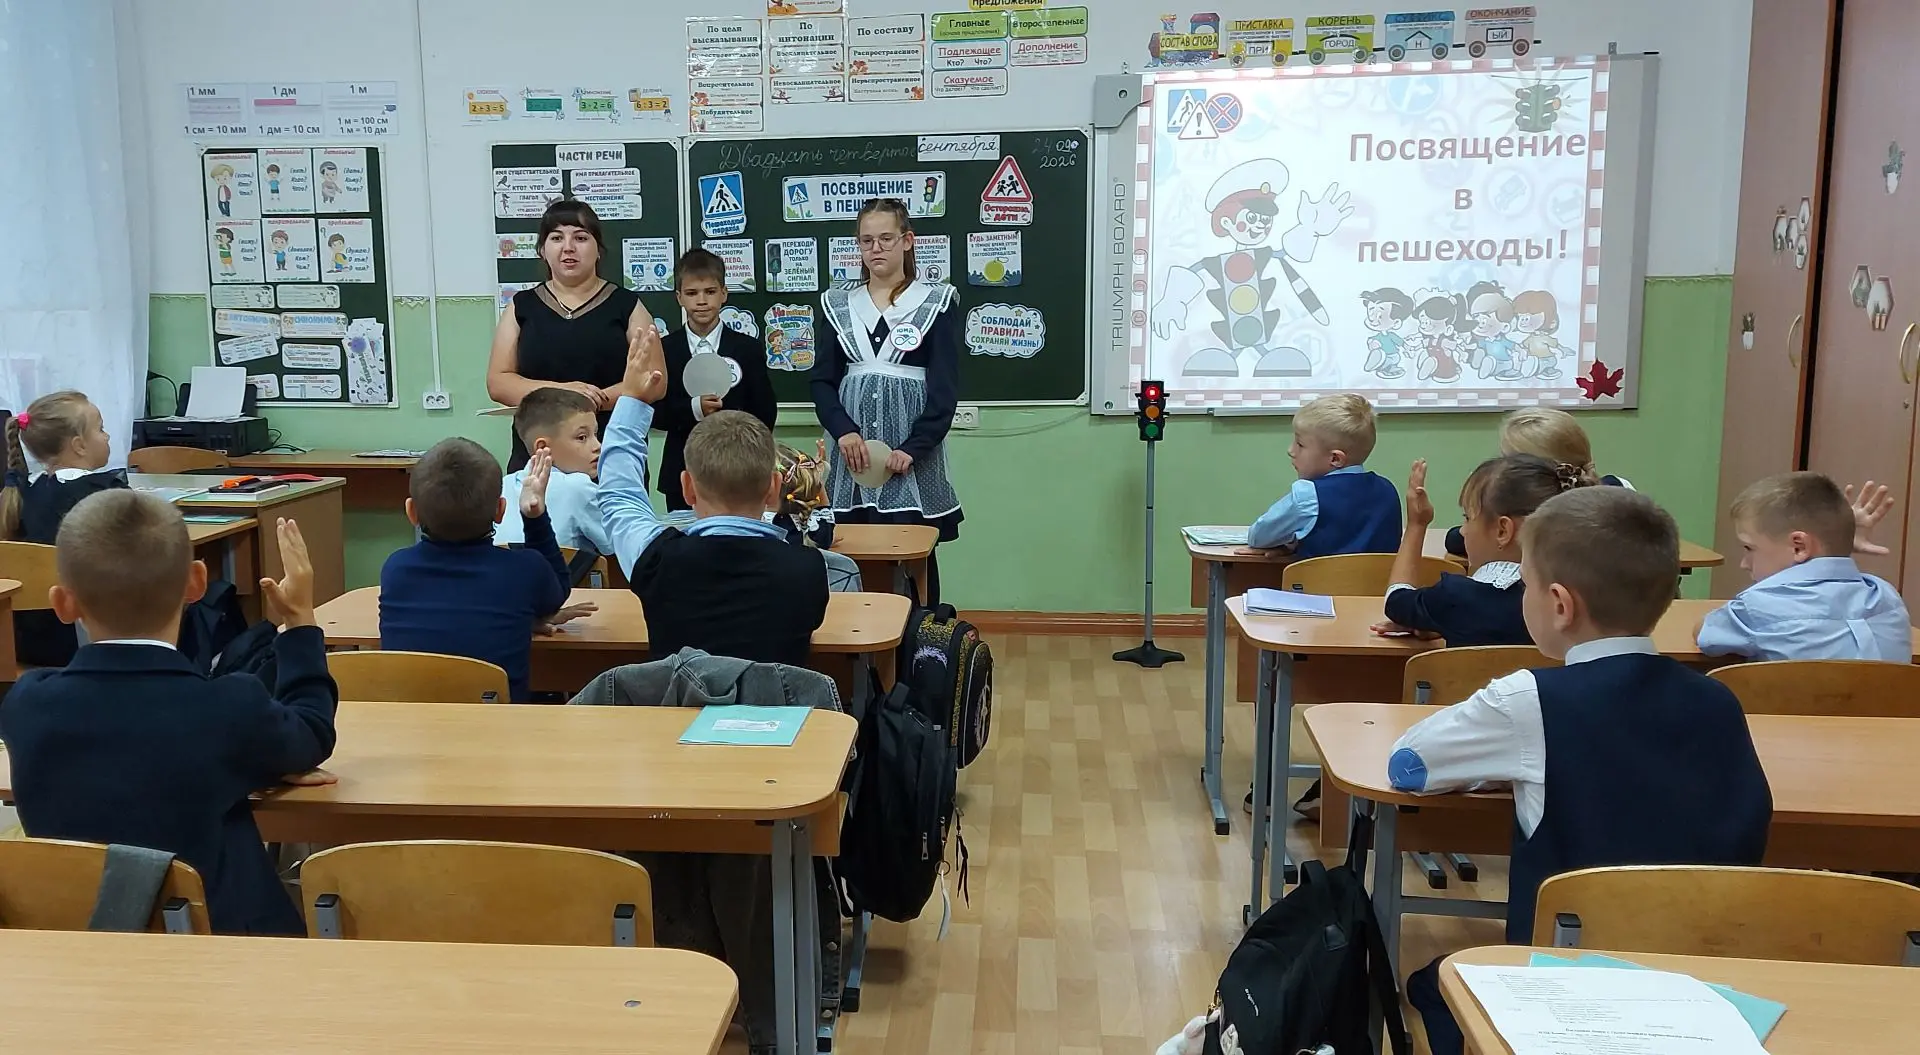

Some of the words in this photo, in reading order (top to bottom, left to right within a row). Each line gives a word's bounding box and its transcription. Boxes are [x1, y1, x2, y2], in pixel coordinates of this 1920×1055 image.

[1470, 7, 1531, 18] ОКОНЧАНИЕ
[949, 19, 991, 28] Главные
[1234, 19, 1284, 30] ПРИСТАВКА
[1318, 15, 1361, 26] КОРЕНЬ
[800, 22, 813, 30] По
[857, 28, 871, 36] По
[874, 26, 915, 34] составу
[692, 36, 758, 44] высказывания
[778, 34, 835, 43] интонации
[1492, 31, 1508, 40] ЫЙ
[1160, 35, 1190, 47] СОСТАВ
[1324, 39, 1356, 48] ГОРОД
[1415, 40, 1423, 48] Н
[938, 47, 1001, 57] Подлежащее
[1018, 42, 1079, 52] Дополнение
[1249, 46, 1270, 55] ПРИ
[946, 58, 965, 67] Кто?
[974, 57, 993, 66] Что?
[943, 75, 994, 86] Сказуемое
[190, 87, 195, 96] 1
[198, 88, 216, 96] мм
[272, 86, 277, 95] 1
[280, 87, 297, 97] дм
[350, 85, 355, 94] 1
[471, 104, 477, 112] 2
[485, 104, 491, 112] 3
[499, 104, 505, 112] 5
[580, 101, 586, 109] 3
[593, 101, 598, 109] 2
[606, 101, 612, 109] 6
[636, 101, 642, 109] 6
[648, 101, 653, 109] 3
[662, 100, 668, 108] 2
[338, 116, 342, 125] 1
[361, 116, 375, 125] 100
[184, 126, 189, 134] 1
[216, 125, 228, 134] 10
[259, 125, 264, 134] 1
[266, 127, 282, 136] дм
[293, 125, 303, 134] 10
[340, 126, 344, 134] 1
[363, 125, 373, 134] 10
[374, 127, 387, 135] дм
[1349, 132, 1586, 163] Посвящение
[559, 150, 593, 161] ЧАСТИ
[595, 150, 623, 160] РЕЧИ
[1039, 153, 1077, 168] 2026
[719, 143, 823, 180] Двадцать
[821, 180, 913, 196] ПОСВЯЩЕНИЕ
[1454, 186, 1473, 212] в
[824, 200, 832, 213] В
[704, 217, 745, 230] Пешеходный
[712, 224, 740, 235] переход
[783, 248, 814, 256] ДОРОГУ
[832, 246, 855, 254] ДОРОГУ
[1357, 229, 1569, 265] пешеходы!
[784, 266, 815, 274] ЗЕЛЁНЫЙ
[1111, 262, 1125, 352] TRIUMPH
[981, 315, 1032, 328] СОБЛЮДАЙ
[980, 326, 1025, 338] ПРАВИЛА
[971, 335, 1010, 346] СОХРАНЯЙ
[1010, 340, 1040, 348] ЖИЗНЬ!
